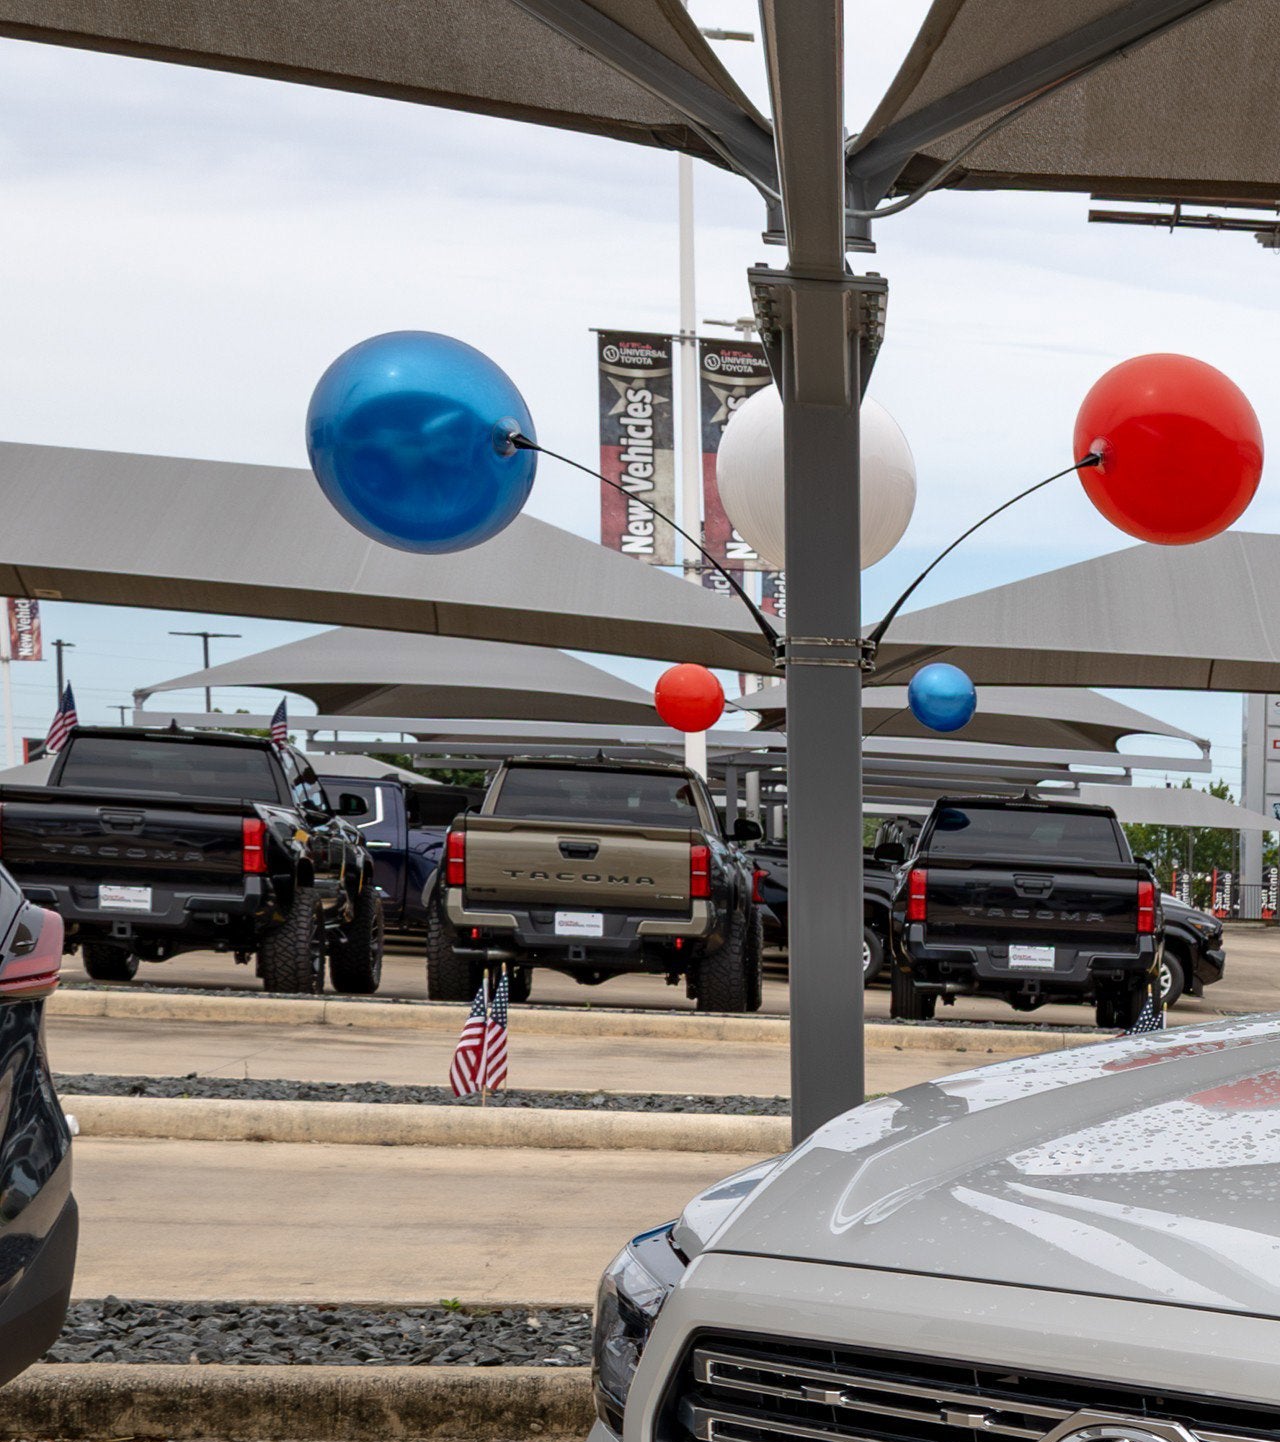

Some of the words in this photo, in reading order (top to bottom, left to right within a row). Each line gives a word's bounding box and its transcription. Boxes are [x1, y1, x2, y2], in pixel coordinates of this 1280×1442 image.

[619, 348, 668, 359] UNIVERSAL
[620, 356, 653, 365] TOYOTA
[720, 356, 769, 367] UNIVERSAL
[721, 364, 754, 373] TOYOTA
[619, 388, 654, 495] Vehicles
[621, 499, 654, 554] New
[14, 599, 32, 632] Vehicl
[18, 633, 34, 657] New
[41, 843, 204, 862] TACOMA
[502, 869, 656, 886] TACOMA
[1267, 867, 1278, 911] Antonio
[960, 906, 1105, 922] TACOMA
